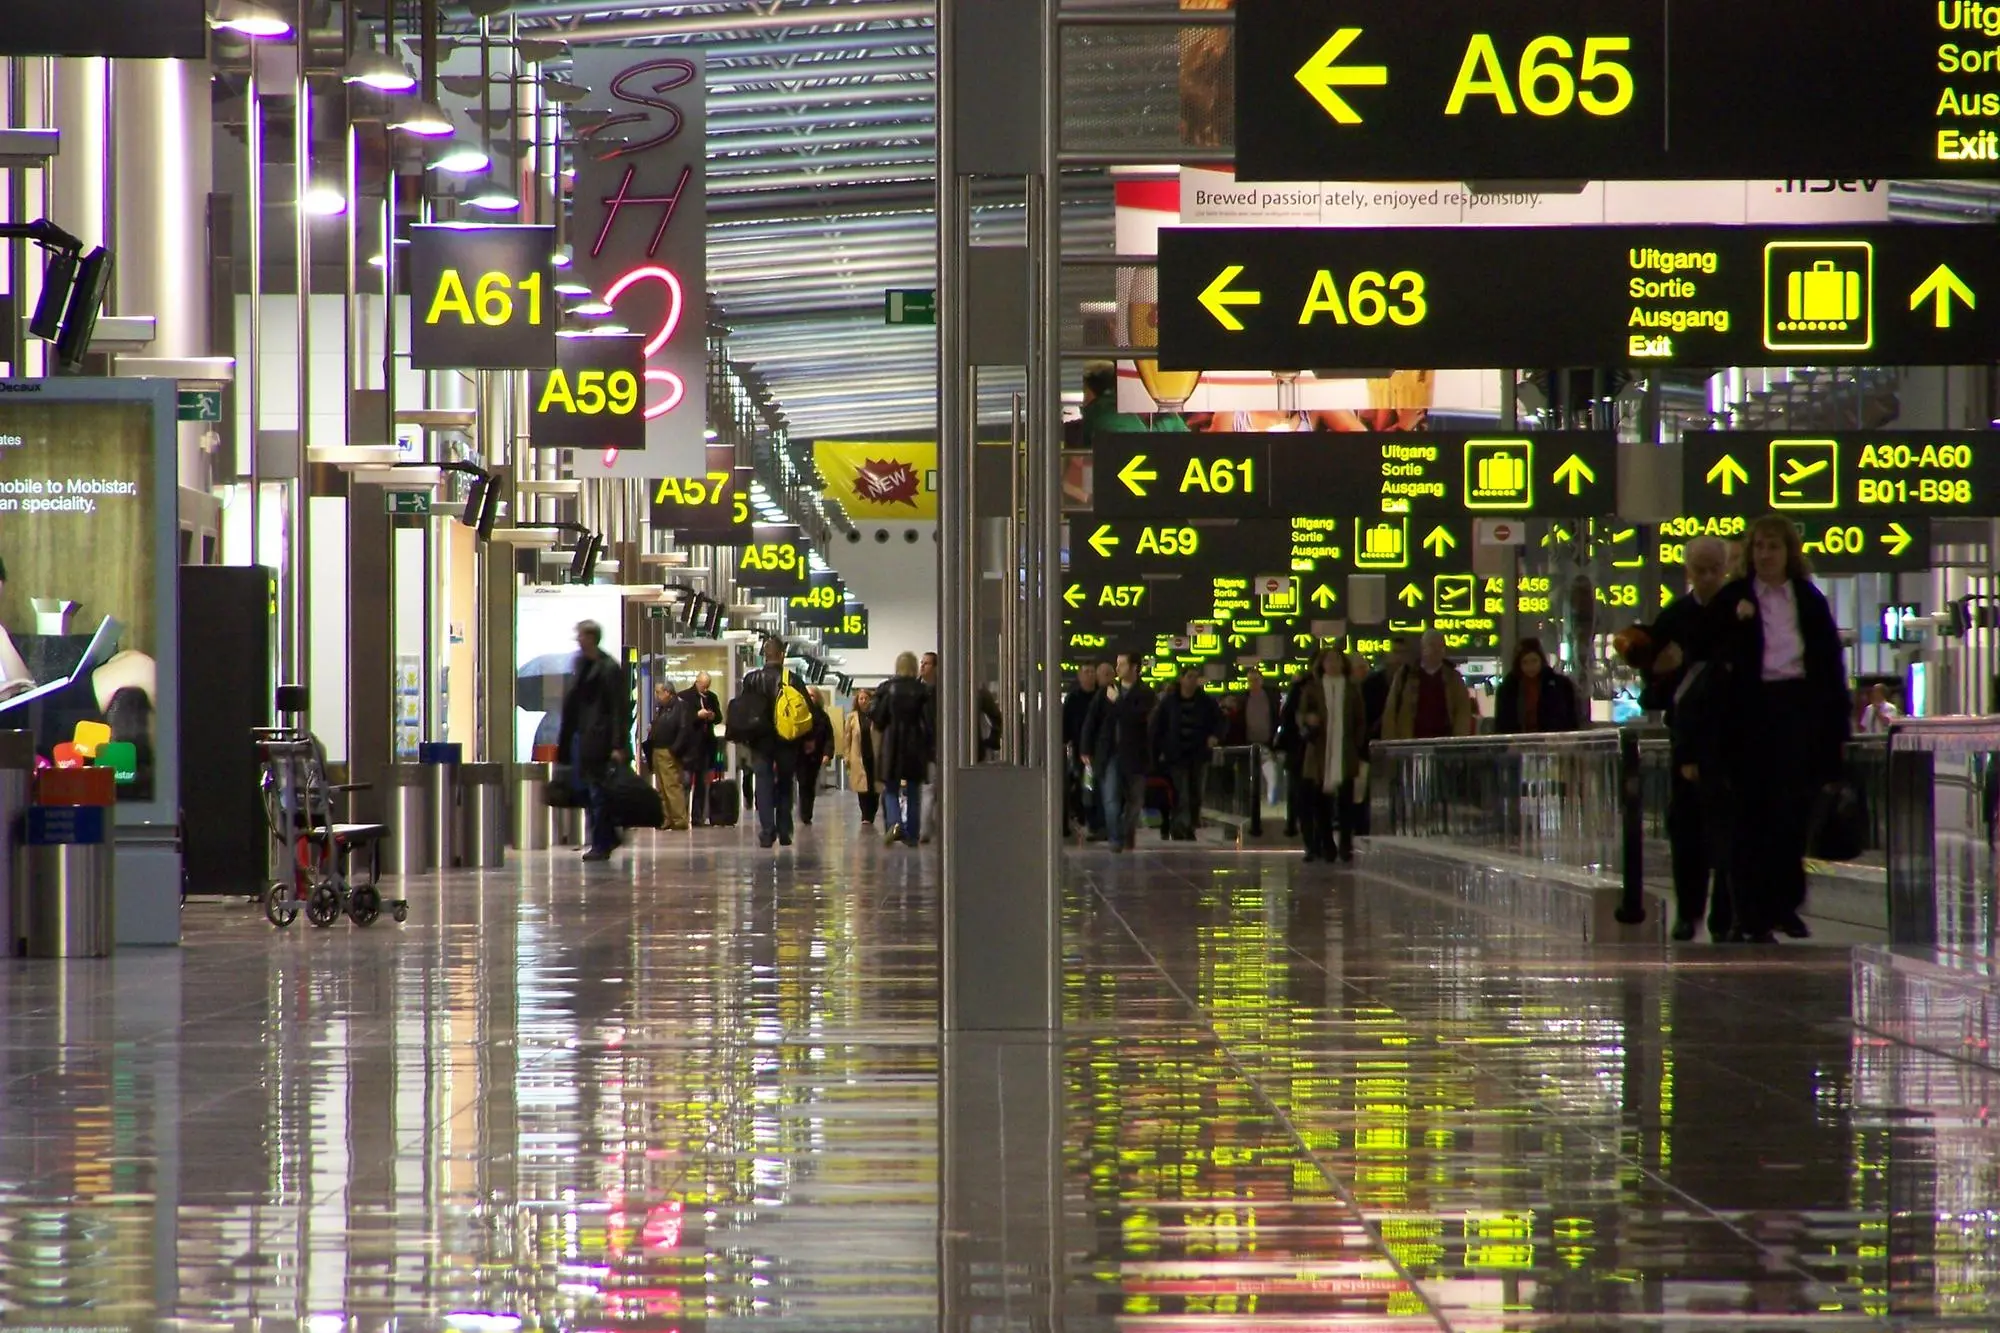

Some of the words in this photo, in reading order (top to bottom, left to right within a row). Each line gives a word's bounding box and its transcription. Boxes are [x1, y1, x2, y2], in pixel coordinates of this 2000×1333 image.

[1445, 34, 1633, 116] A65
[1938, 130, 1999, 160] Exit
[1196, 190, 1257, 206] Brewed
[1373, 190, 1438, 211] enjoyed
[1630, 248, 1716, 273] Uitgang
[426, 269, 540, 326] A61
[1299, 270, 1426, 326] A63
[1630, 278, 1695, 298] Sortie
[1628, 307, 1728, 332] Ausgang
[1629, 335, 1672, 357] Exit
[538, 369, 637, 414] A59
[1382, 445, 1436, 461] Uitgang
[1858, 445, 1971, 468] A30-A60
[1180, 458, 1252, 493] A61
[1382, 463, 1422, 476] Sortie
[46, 479, 64, 494] to
[67, 479, 137, 496] Mobistar,
[656, 475, 730, 505] A57
[866, 470, 907, 498] NEW
[1381, 481, 1443, 499] Ausgang
[1858, 479, 1971, 503] B01-B98
[21, 496, 96, 513] speciality.
[1660, 517, 1744, 536] A30-A58
[1136, 527, 1197, 555] A59
[740, 543, 796, 570] A53
[1099, 586, 1144, 606] A57
